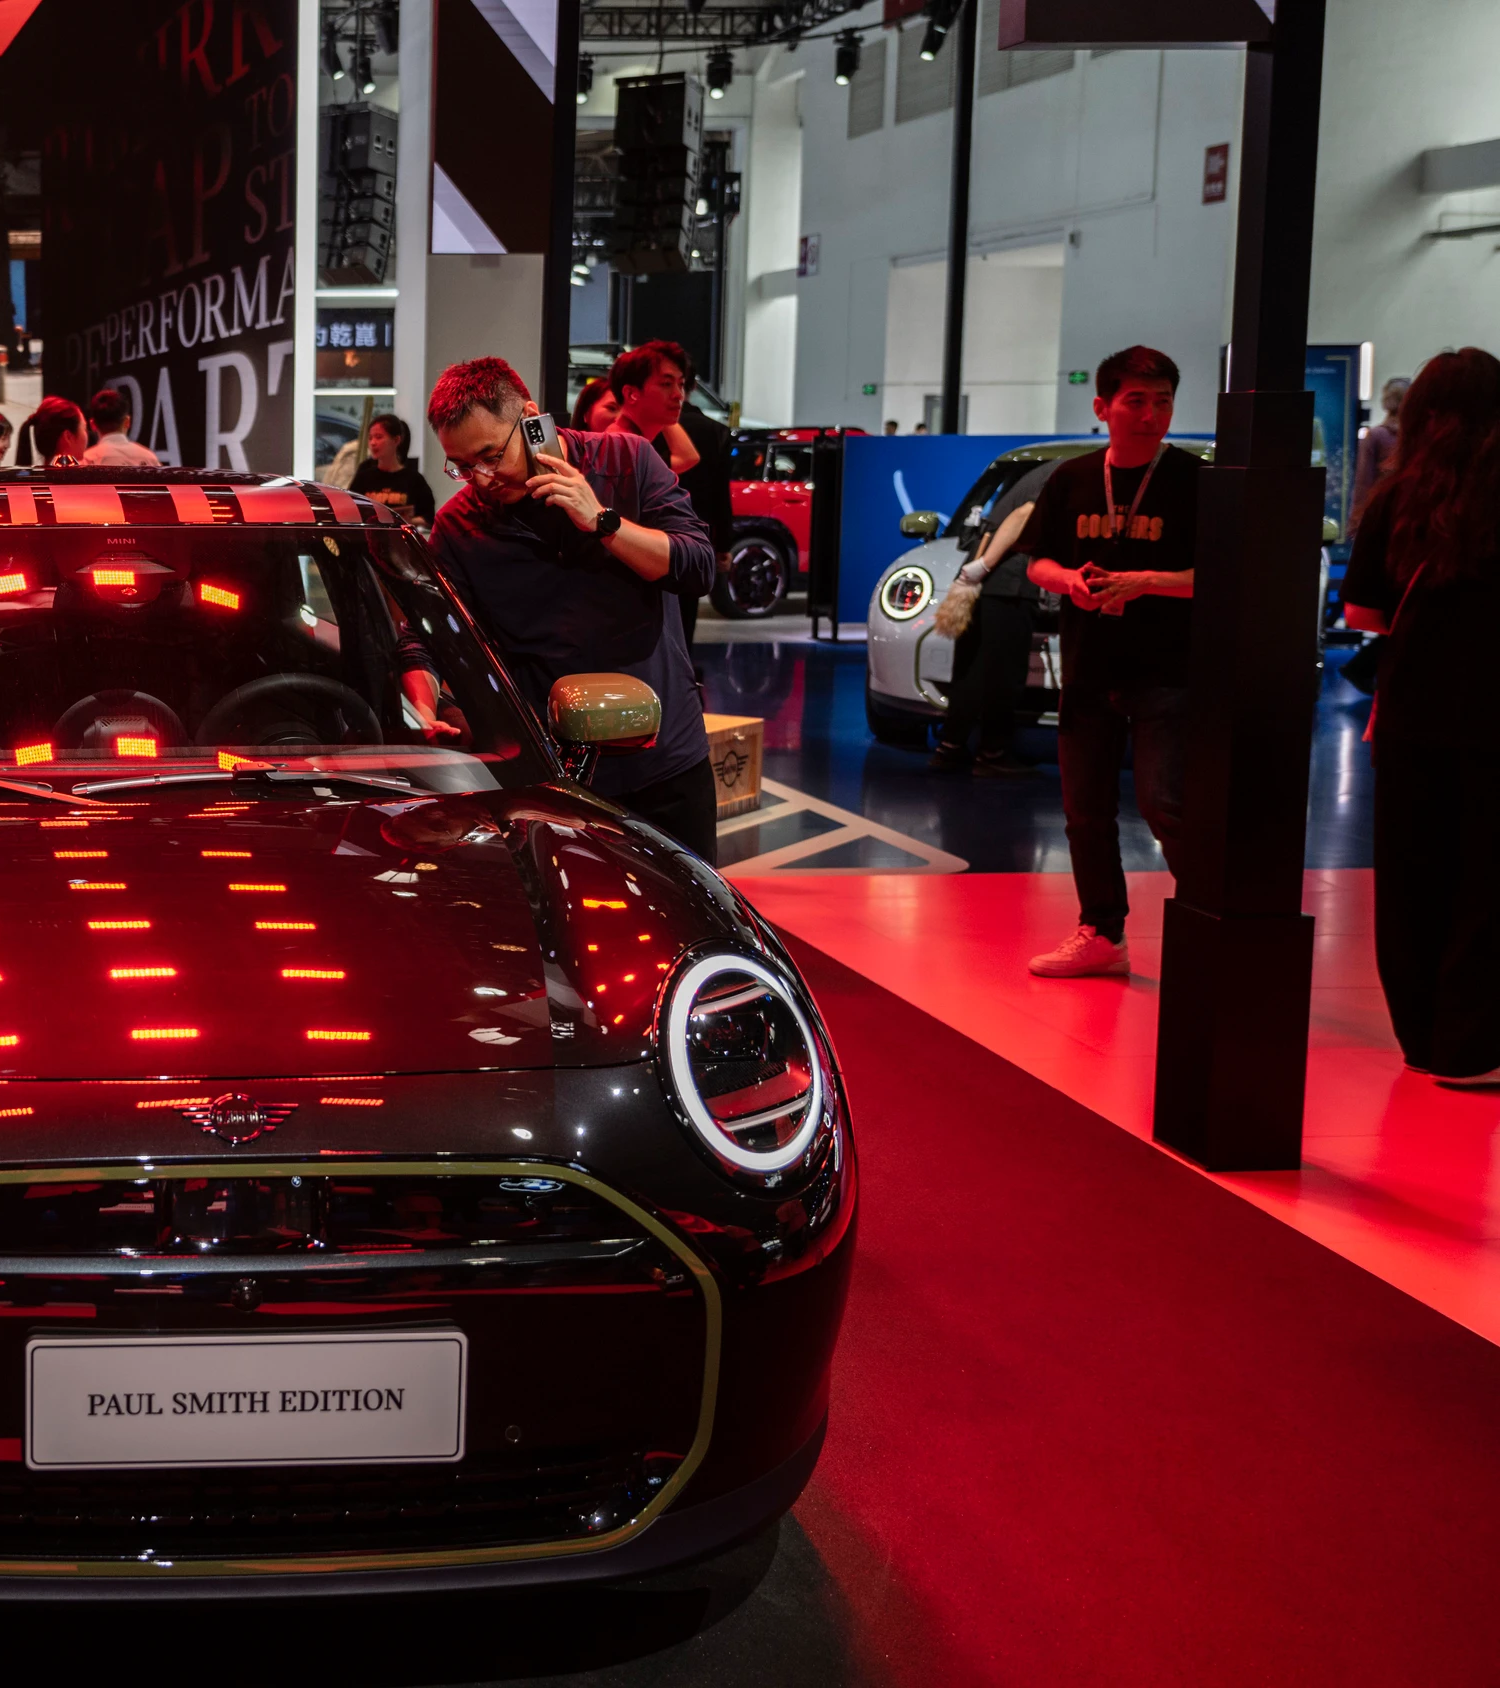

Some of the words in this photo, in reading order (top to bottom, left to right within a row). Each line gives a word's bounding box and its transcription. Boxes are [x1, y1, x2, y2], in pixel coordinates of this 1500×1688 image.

[87, 1393, 163, 1417] PAUL
[172, 1391, 270, 1415] SMITH
[279, 1388, 405, 1412] EDITION
